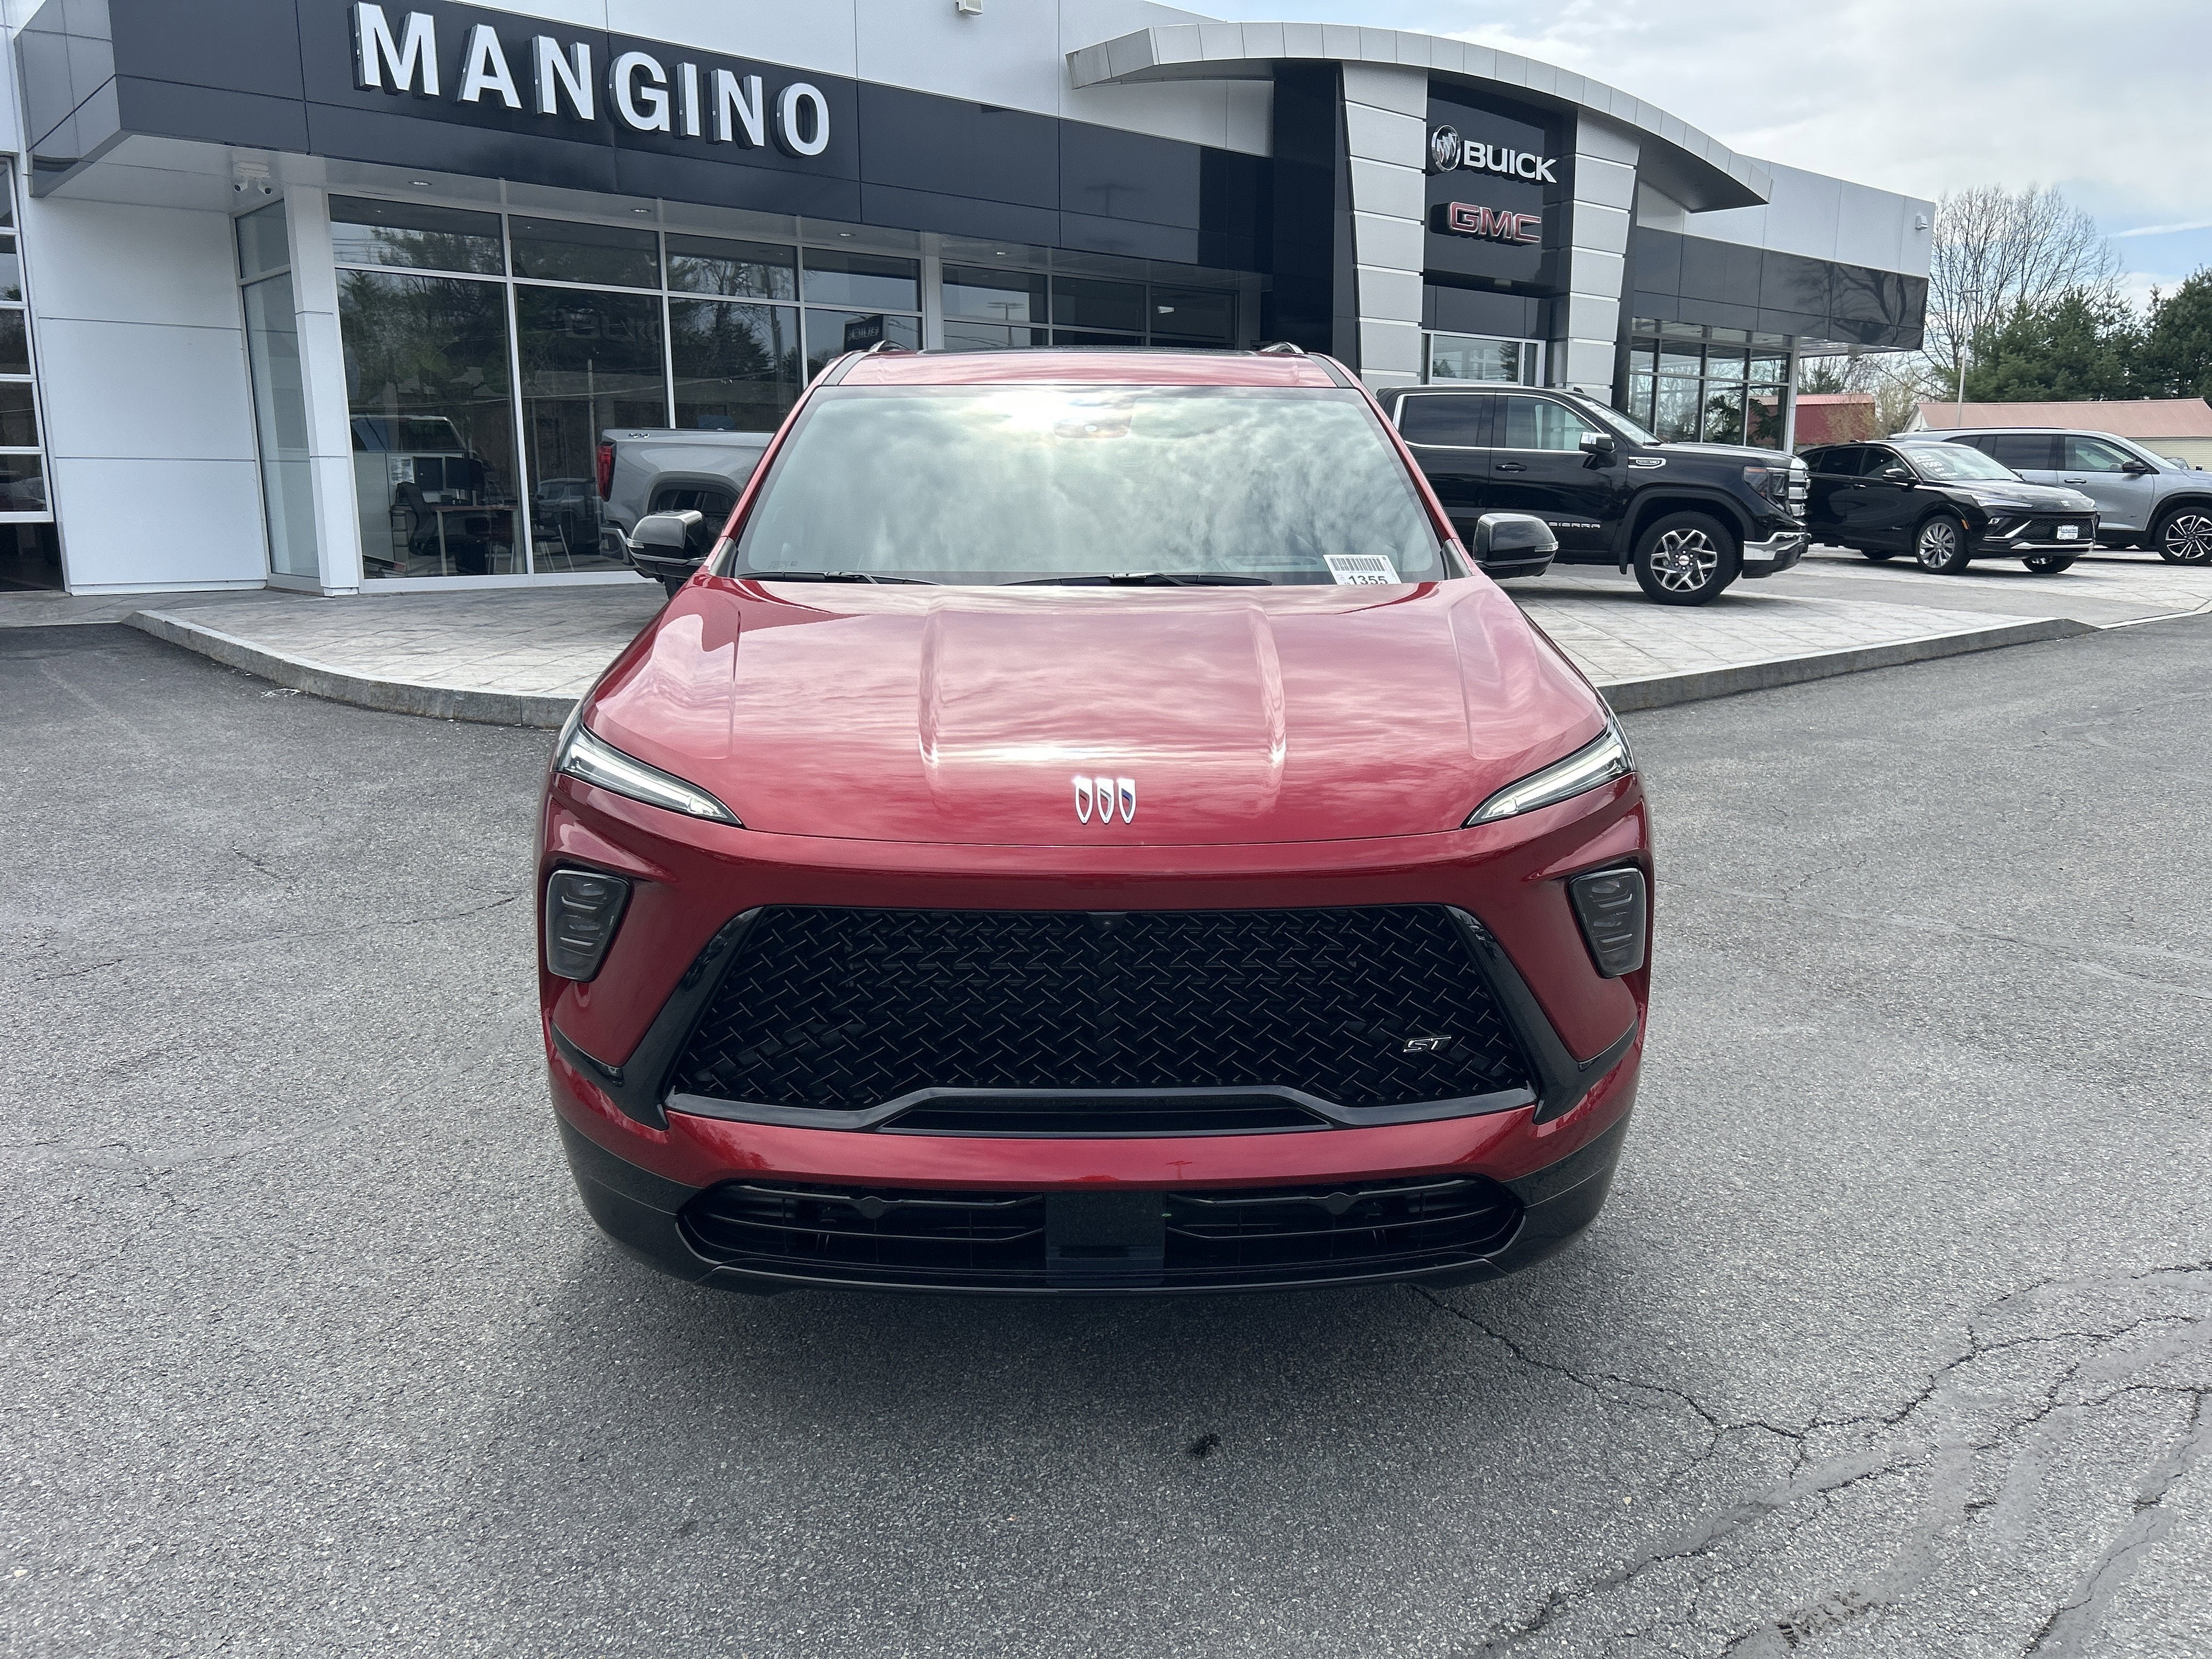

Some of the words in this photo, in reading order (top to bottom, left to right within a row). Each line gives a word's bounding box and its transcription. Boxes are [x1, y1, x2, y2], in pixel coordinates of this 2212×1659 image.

[352, 1, 830, 157] MANGINO
[1464, 139, 1558, 183] BUICK
[1449, 201, 1542, 243] GMC
[1348, 575, 1388, 585] 1355
[1402, 1035, 1452, 1053] ST
